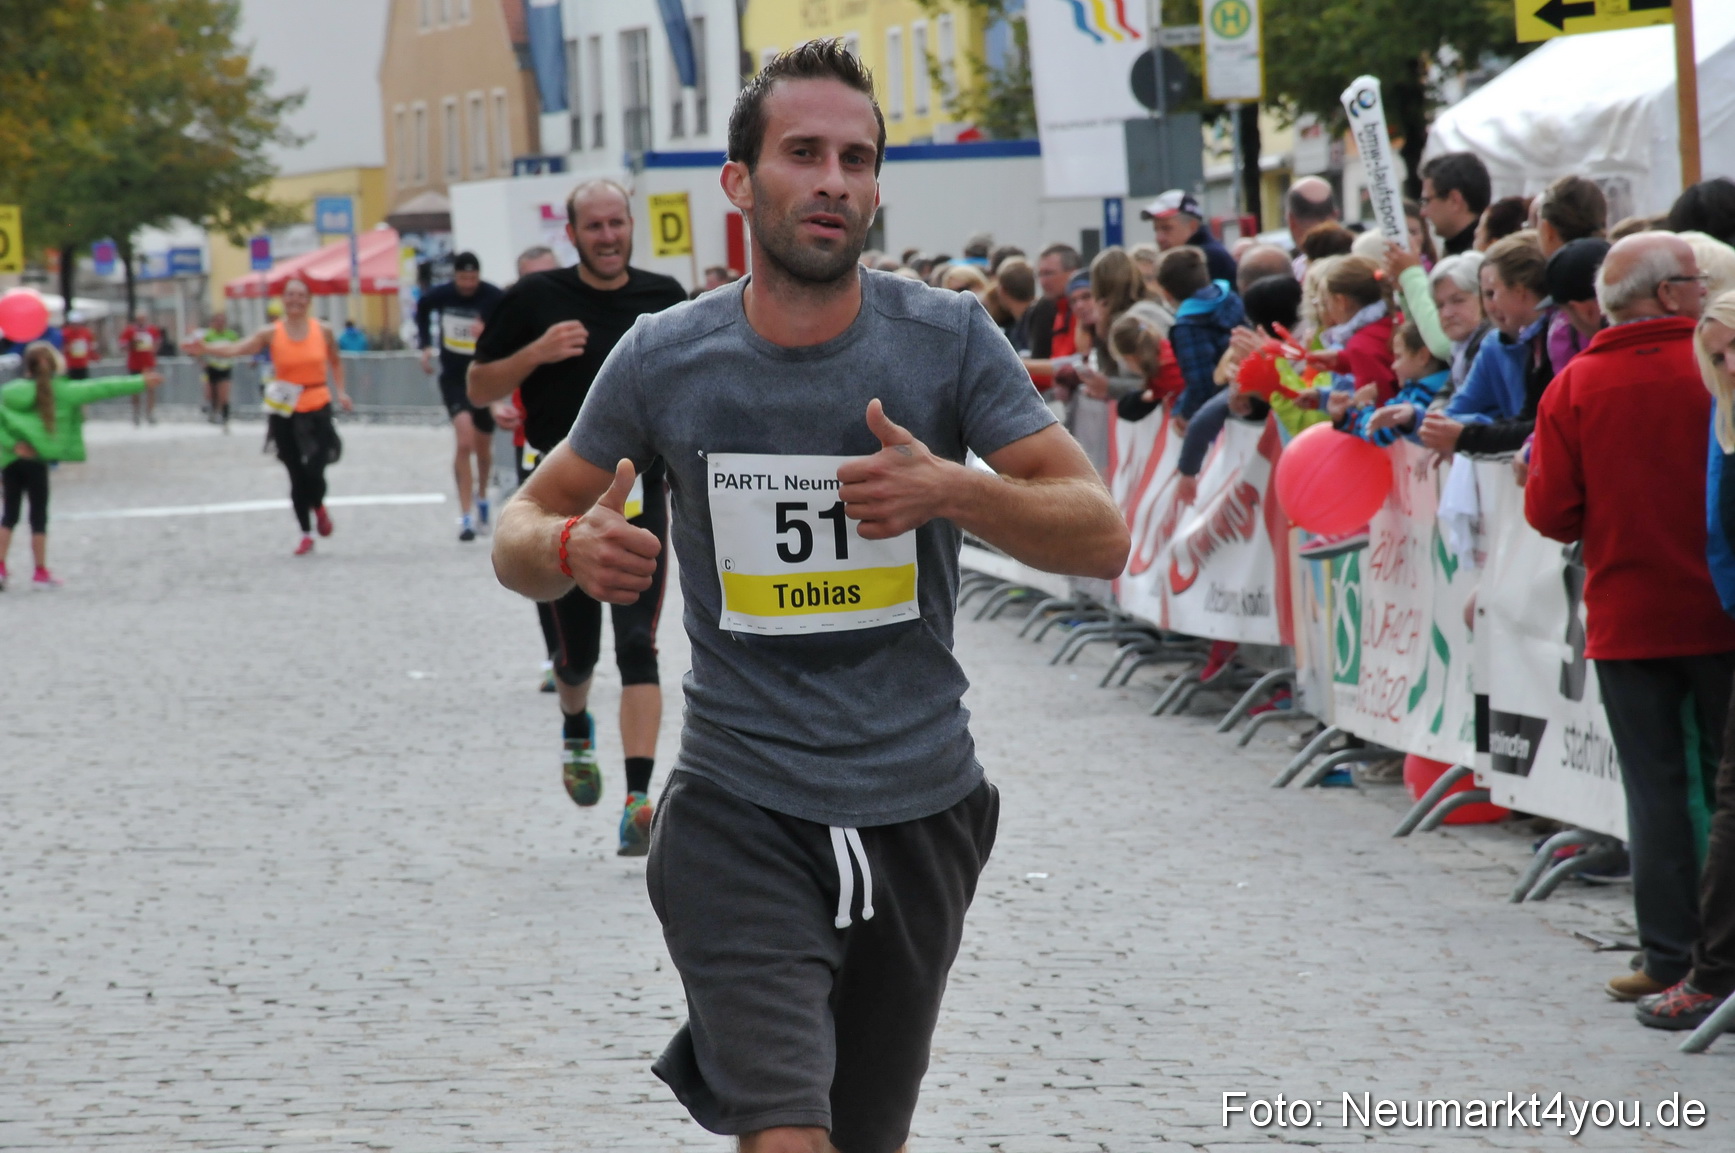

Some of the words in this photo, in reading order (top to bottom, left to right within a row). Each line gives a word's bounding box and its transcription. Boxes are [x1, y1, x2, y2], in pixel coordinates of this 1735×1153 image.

[660, 212, 682, 243] D
[714, 473, 779, 490] PARTL
[784, 474, 840, 491] Neum
[775, 501, 849, 563] 51
[773, 581, 861, 608] Tobias
